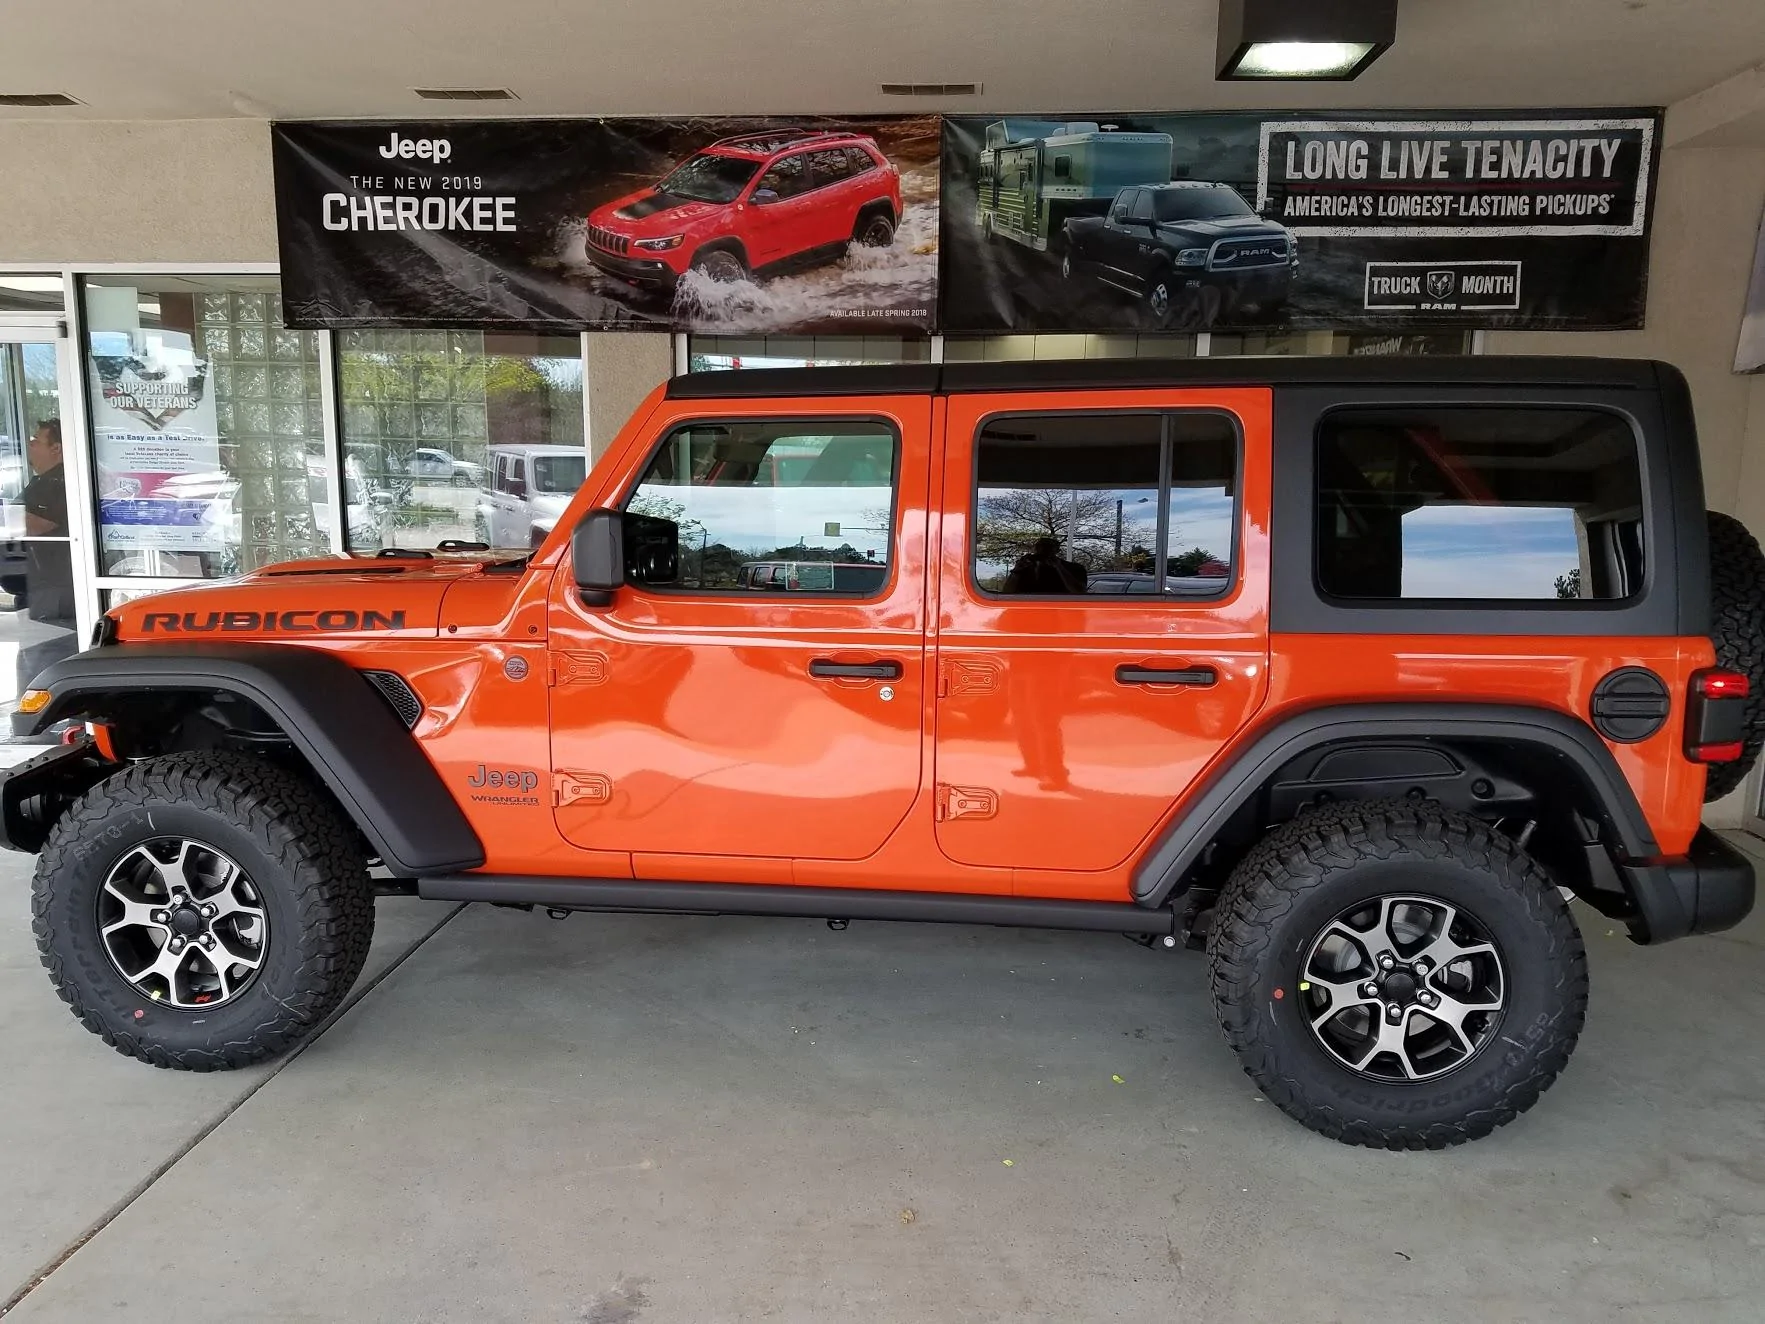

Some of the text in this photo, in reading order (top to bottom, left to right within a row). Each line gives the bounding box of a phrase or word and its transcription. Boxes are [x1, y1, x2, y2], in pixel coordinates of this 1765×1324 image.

[379, 132, 451, 164] Jeep
[1285, 138, 1622, 180] LONG LIVE TENACITY
[350, 176, 482, 190] THE NEW 2019
[322, 193, 517, 232] CHEROKEE
[1284, 196, 1373, 217] AMERICA'S
[1378, 196, 1530, 217] LONGEST-LASTING
[1371, 275, 1514, 294] TRUCK MONTH
[885, 309, 910, 317] SPRING
[115, 382, 189, 395] SUPPORTING
[111, 396, 197, 409] OUR VETERANS
[140, 610, 407, 633] RUBICON
[467, 764, 539, 793] Jeep
[471, 795, 539, 803] WRANGLER
